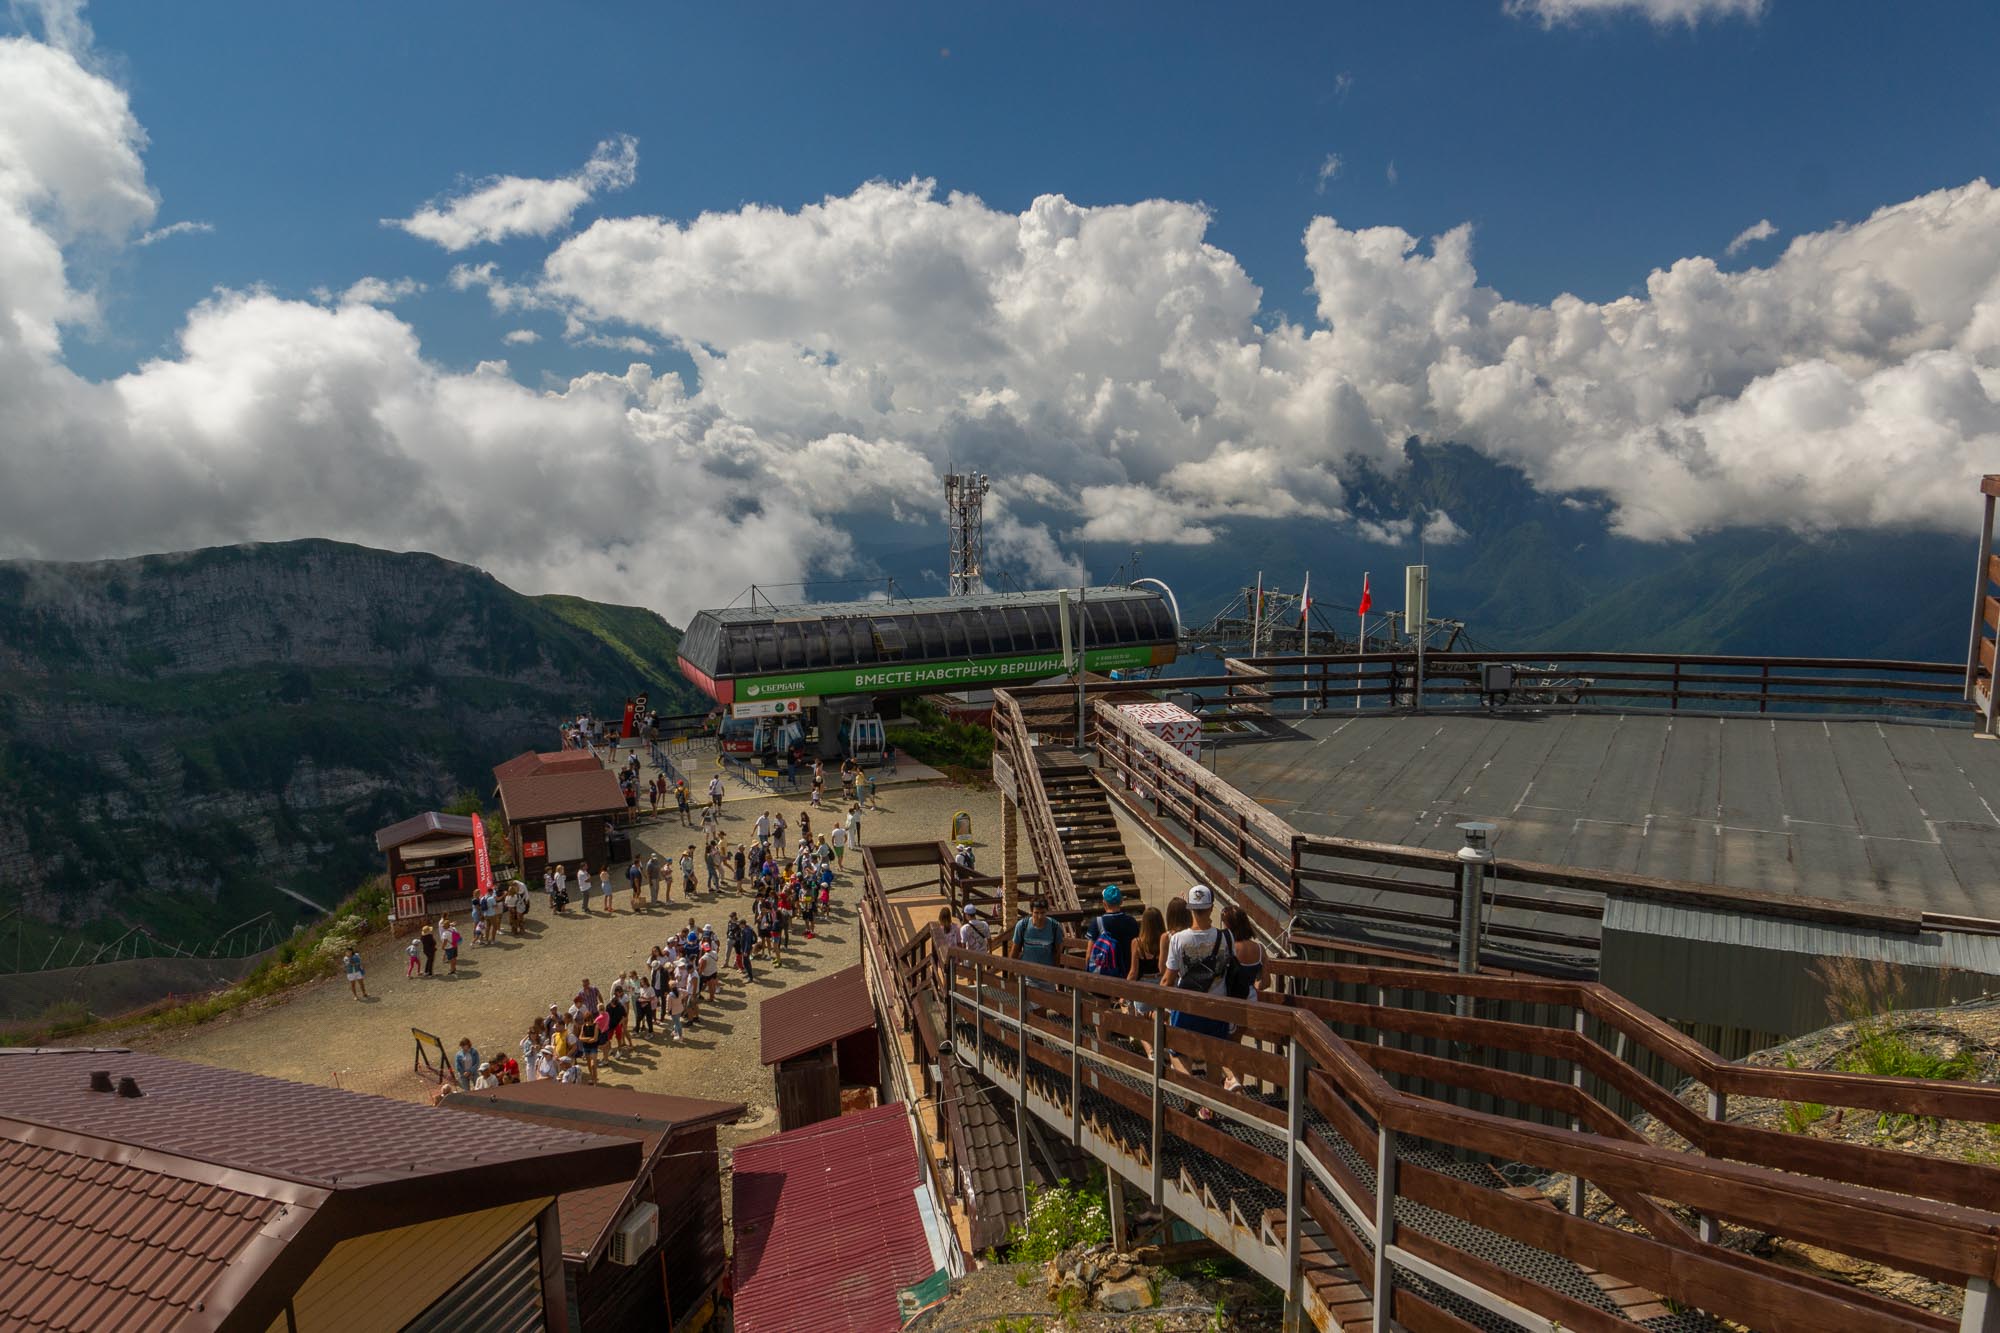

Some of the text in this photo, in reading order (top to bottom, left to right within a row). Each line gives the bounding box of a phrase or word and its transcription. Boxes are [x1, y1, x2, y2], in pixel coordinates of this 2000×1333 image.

[855, 671, 912, 686] ВМЕСТЕ
[915, 664, 998, 681] НАВСТРЕЧУ
[761, 681, 805, 693] СБЕРБАНК
